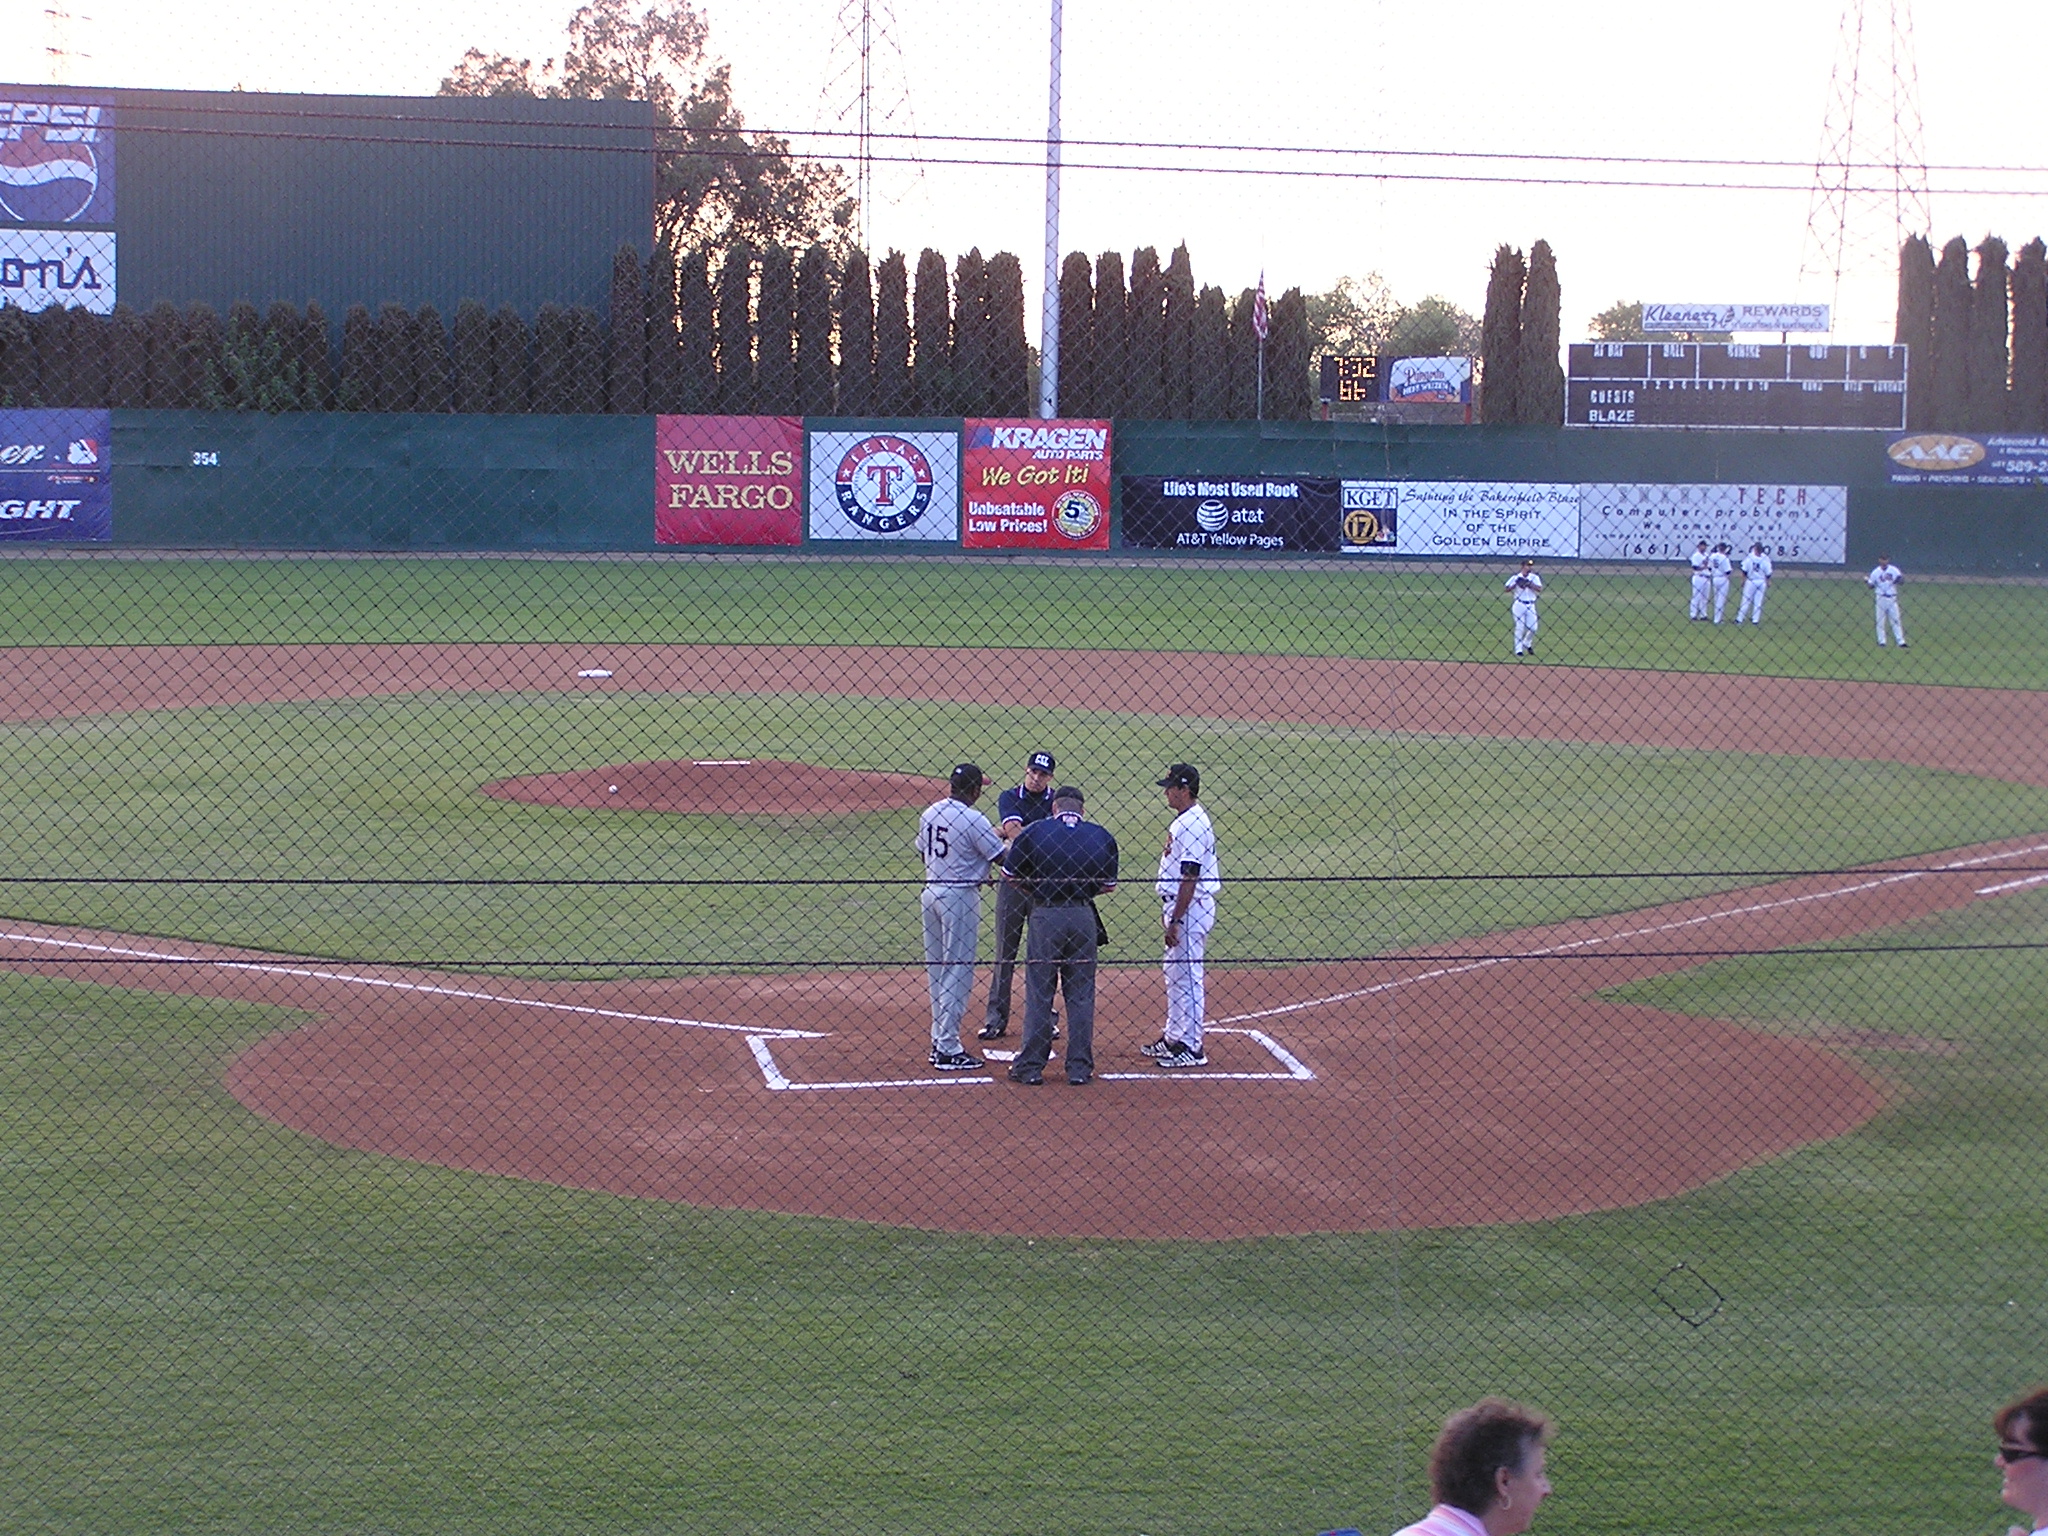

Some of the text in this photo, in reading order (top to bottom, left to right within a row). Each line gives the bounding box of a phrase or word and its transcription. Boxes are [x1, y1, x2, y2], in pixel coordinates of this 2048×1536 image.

[1742, 306, 1822, 317] REWARDS
[1590, 390, 1634, 403] GUESTS
[1589, 410, 1635, 422] BLAZE
[991, 427, 1108, 449] KRAGEN
[193, 451, 219, 466] 354
[852, 438, 920, 464] TEXAS
[1032, 450, 1104, 461] AUTO PARTS
[664, 450, 793, 476] WELLS
[982, 463, 1089, 486] We Got It!
[867, 465, 904, 507] T
[1164, 481, 1299, 498] Life's Most Used Book
[668, 484, 793, 510] FARGO
[1346, 490, 1397, 507] KGET
[1401, 489, 1581, 506] Saluting the Bakersfield Blaze
[1738, 487, 1806, 505] TECH
[841, 491, 927, 530] RANGERS
[969, 501, 1045, 516] Unbeatable
[1231, 507, 1264, 523] at&t
[1443, 508, 1541, 520] IN THE SPIRIT
[1602, 506, 1824, 519] Computer problems?
[968, 518, 1048, 533] Low Prices!
[1350, 515, 1374, 537] 17
[1466, 524, 1517, 533] OF THE
[1176, 533, 1284, 549] AT&T Yellow Pages
[1432, 535, 1550, 547] GOLDEN EMPIRE
[1623, 543, 1680, 557] (661)
[927, 823, 948, 859] 15
